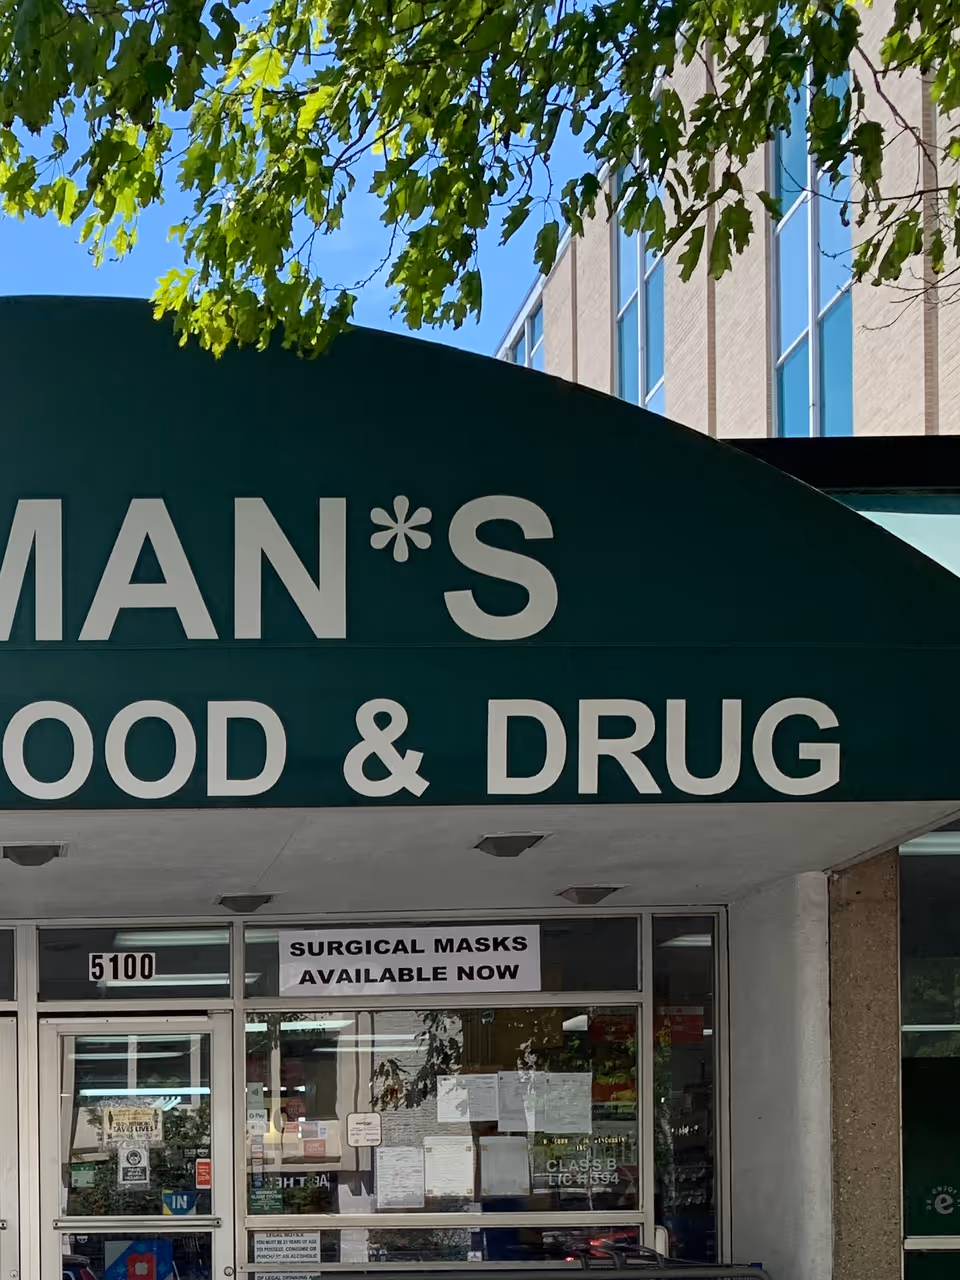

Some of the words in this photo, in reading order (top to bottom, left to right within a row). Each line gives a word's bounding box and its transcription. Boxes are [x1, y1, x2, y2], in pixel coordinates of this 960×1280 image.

[343, 698, 430, 798] &
[487, 697, 840, 796] DRUG
[289, 939, 425, 957] SURGICAL
[434, 936, 528, 953] MASKS
[91, 953, 154, 980] 5100
[299, 965, 447, 985] AVAILABLE
[457, 964, 520, 981] NOW
[547, 1159, 602, 1172] CLASS
[607, 1158, 617, 1170] B
[171, 1194, 188, 1209] IN
